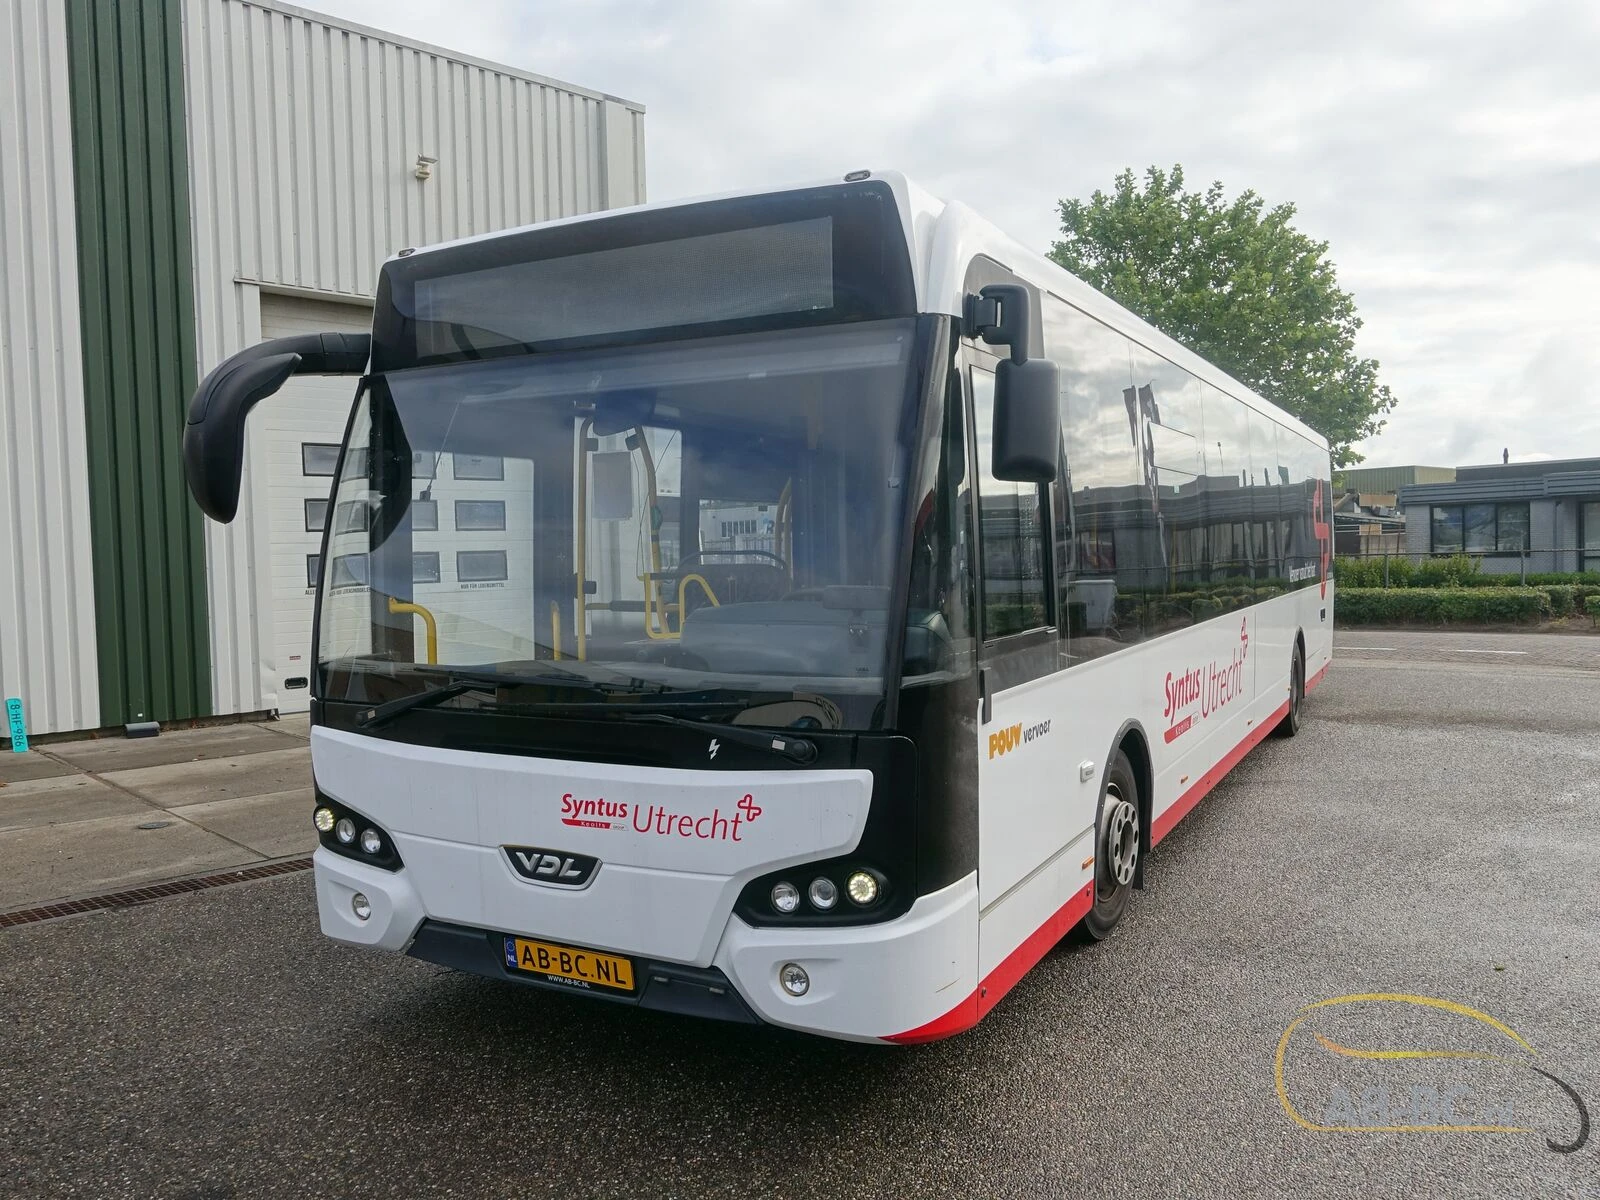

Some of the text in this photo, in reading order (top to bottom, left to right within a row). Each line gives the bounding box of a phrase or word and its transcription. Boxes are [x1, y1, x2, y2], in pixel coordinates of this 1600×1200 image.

[1164, 648, 1243, 727] Syntus Utrecht
[988, 719, 1051, 761] POUW vervoer
[561, 793, 743, 842] Syntus Utrecht
[515, 851, 582, 878] VDL
[507, 944, 627, 985] NL AB-BC.NL
[547, 974, 591, 989] WWW.AB-BC.NL
